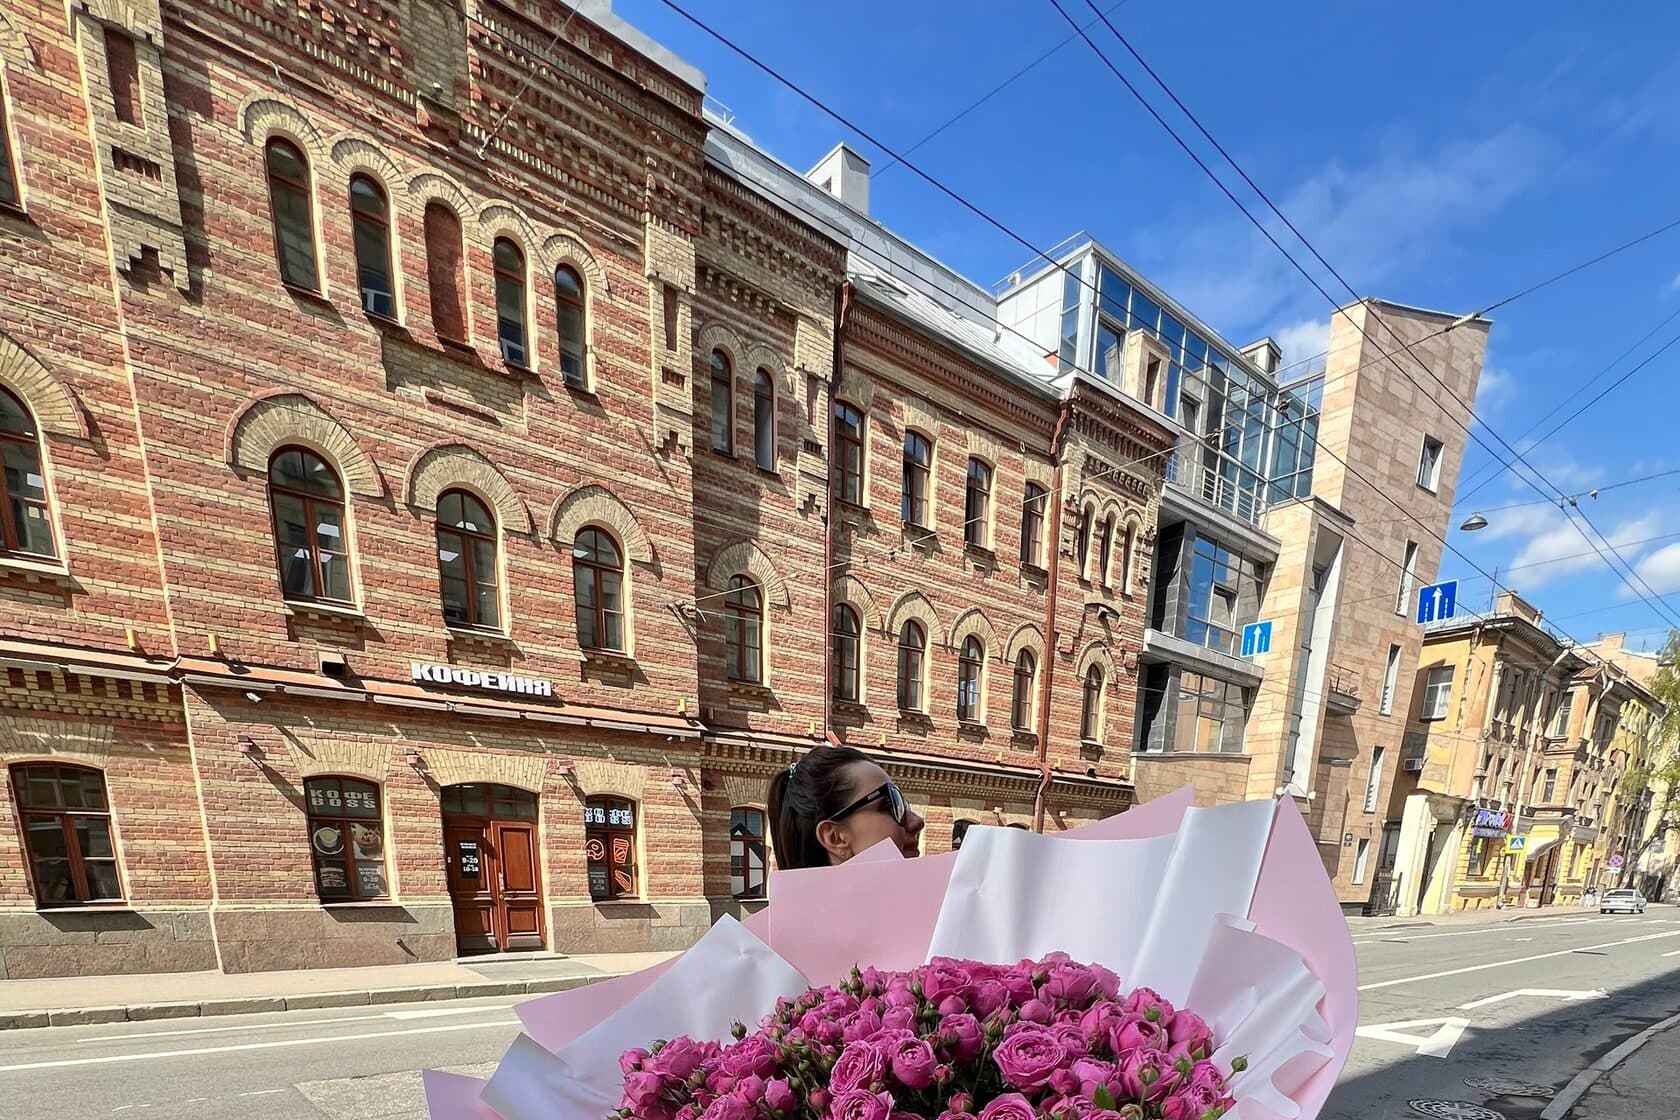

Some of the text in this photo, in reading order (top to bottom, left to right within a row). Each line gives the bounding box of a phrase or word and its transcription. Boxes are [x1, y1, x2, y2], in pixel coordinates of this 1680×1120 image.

[410, 661, 552, 697] КОФЕЙНЯ
[310, 789, 374, 800] КОФЕ
[311, 798, 376, 809] BOSS
